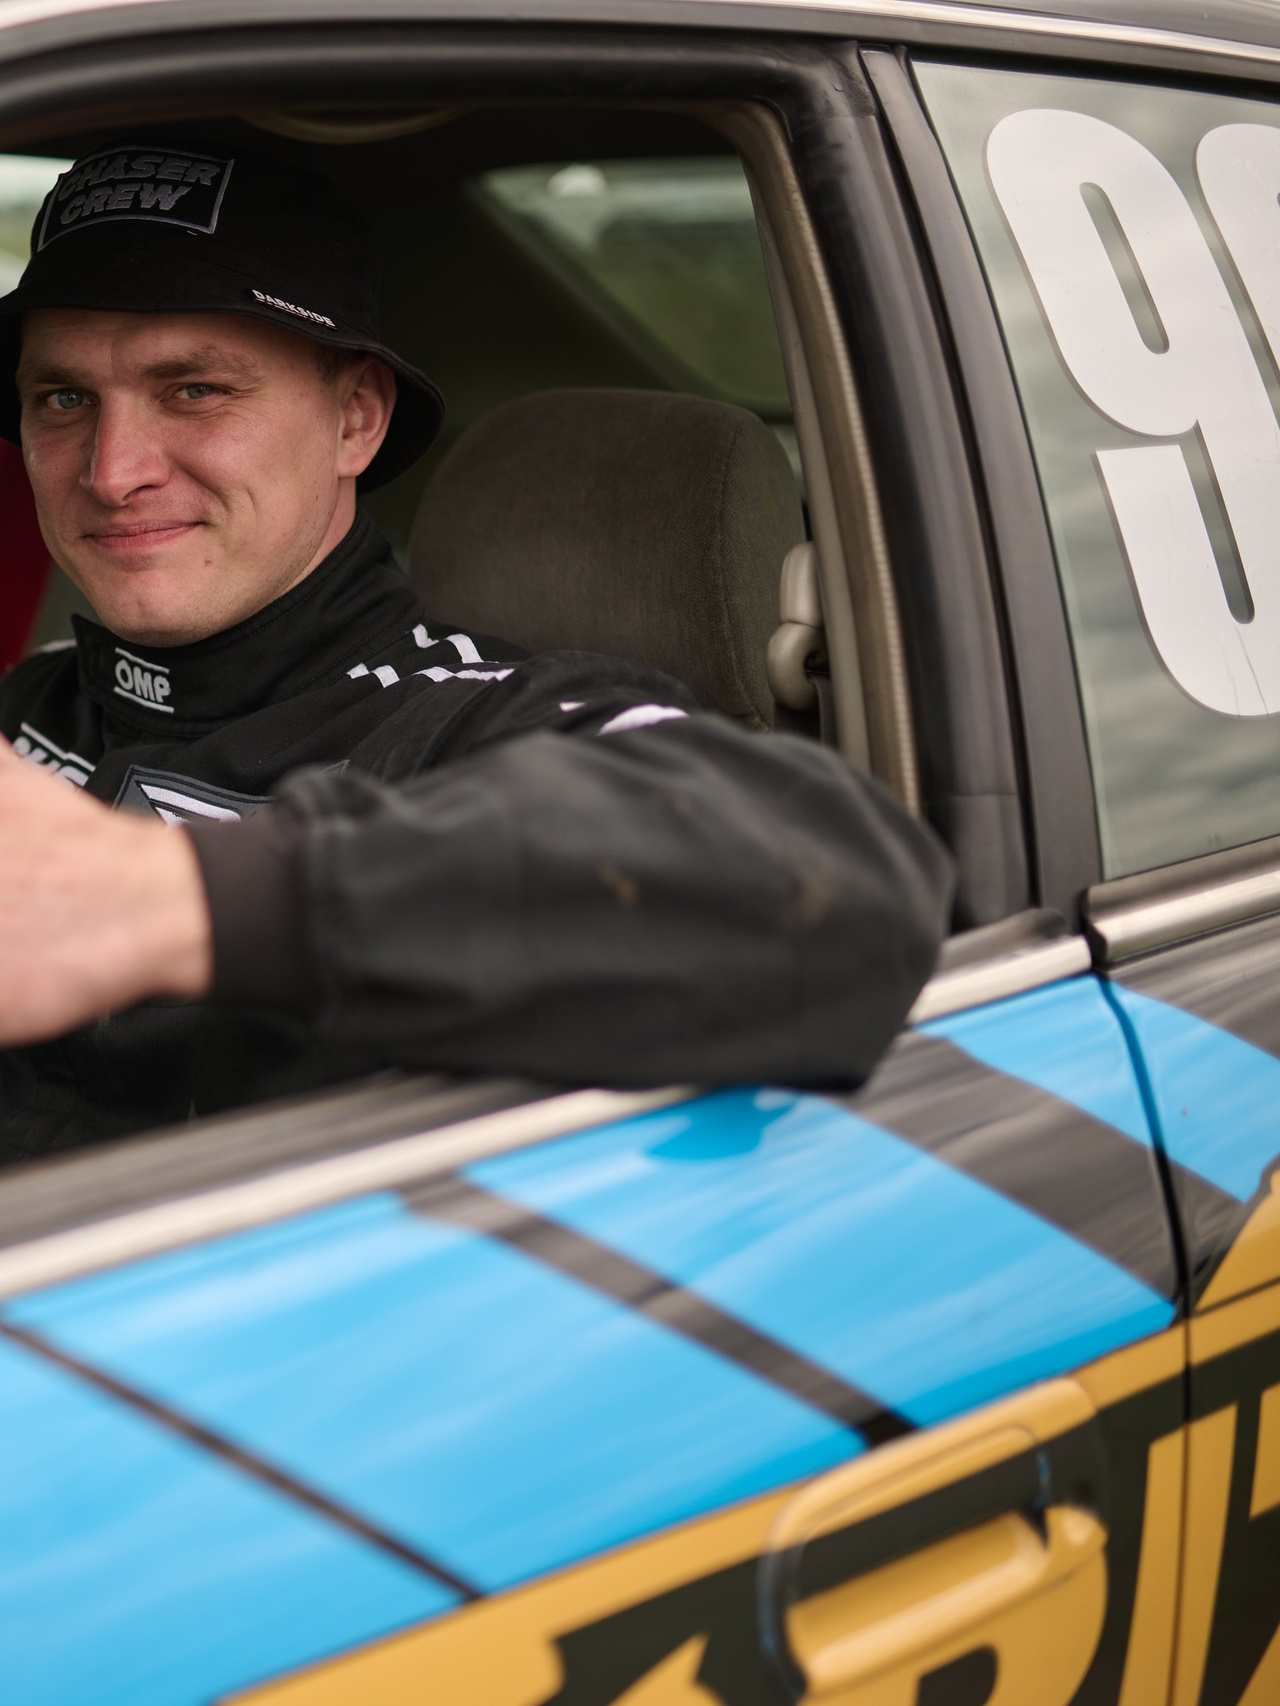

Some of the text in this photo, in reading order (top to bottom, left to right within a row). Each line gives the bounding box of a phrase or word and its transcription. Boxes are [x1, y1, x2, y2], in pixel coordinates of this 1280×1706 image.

[58, 154, 221, 201] CHASER
[60, 182, 193, 225] CREW
[251, 289, 336, 327] DARKSIDE
[115, 659, 171, 703] OMP
